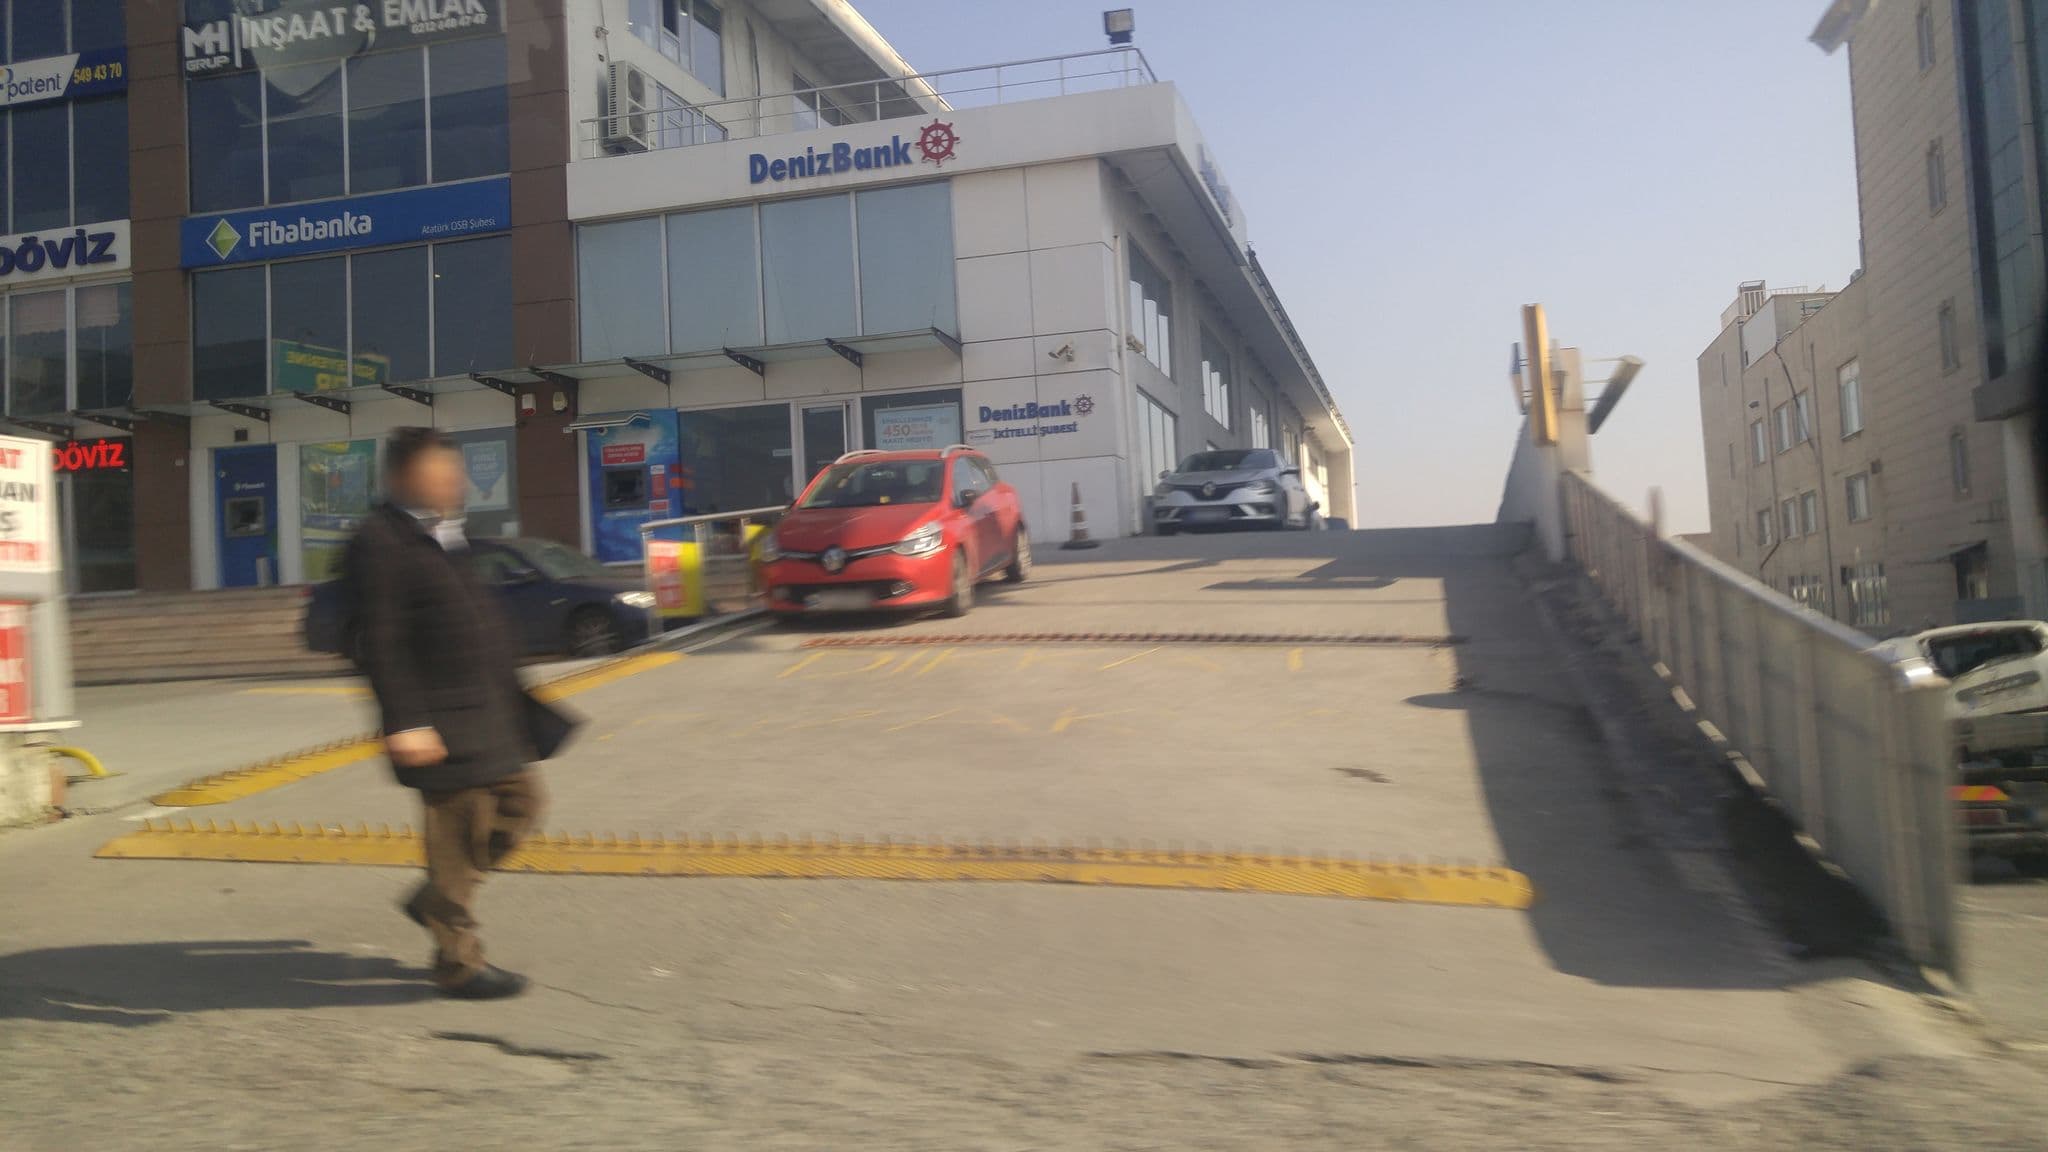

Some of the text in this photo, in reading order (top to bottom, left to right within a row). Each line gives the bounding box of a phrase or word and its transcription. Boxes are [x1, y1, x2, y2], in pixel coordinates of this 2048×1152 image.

[353, 5, 376, 32] &
[185, 55, 230, 72] GRUP
[8, 62, 122, 101] patent 549 43 70
[749, 135, 913, 185] DenizBank
[249, 211, 373, 248] Fibabanka
[979, 400, 1071, 423] DenizBank
[993, 425, 1038, 439] İKİTELLİ
[1040, 421, 1079, 437] ŞUBESİ
[50, 437, 125, 471] DÖVİZ
